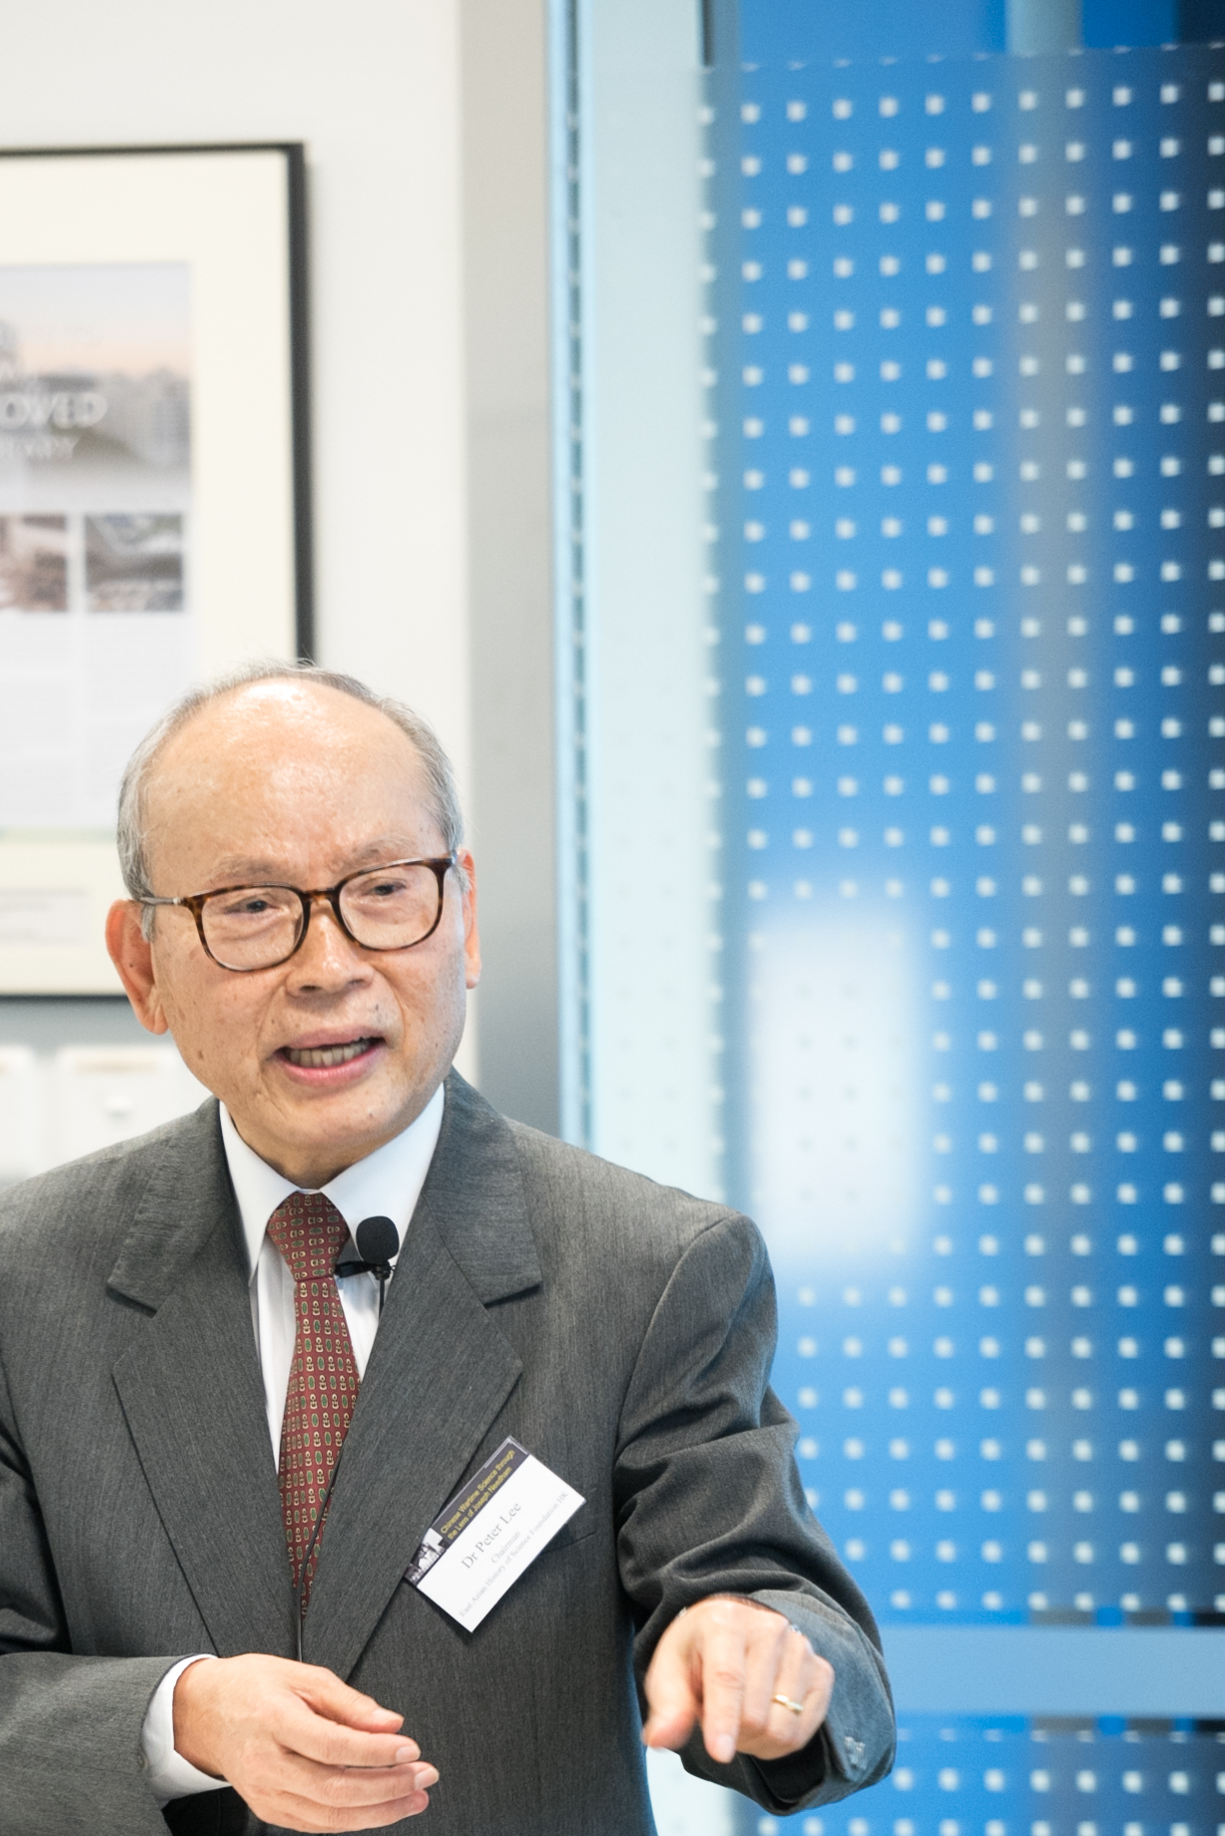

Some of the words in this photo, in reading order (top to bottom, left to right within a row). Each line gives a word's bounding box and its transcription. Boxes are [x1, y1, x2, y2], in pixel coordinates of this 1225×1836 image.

[441, 1512, 461, 1533] Chinese
[459, 1490, 480, 1511] Wartime
[478, 1469, 497, 1490] Science
[496, 1450, 514, 1470] through
[474, 1491, 489, 1510] Joseph
[488, 1467, 511, 1492] Needham
[459, 1603, 473, 1617] East
[472, 1586, 487, 1603] Asian
[485, 1565, 506, 1587] History
[510, 1535, 531, 1557] Science
[529, 1503, 559, 1535] Foundation
[461, 1552, 478, 1569] Dr
[475, 1524, 502, 1553] Peter
[499, 1503, 521, 1524] Lee
[491, 1532, 521, 1563] Chairman
